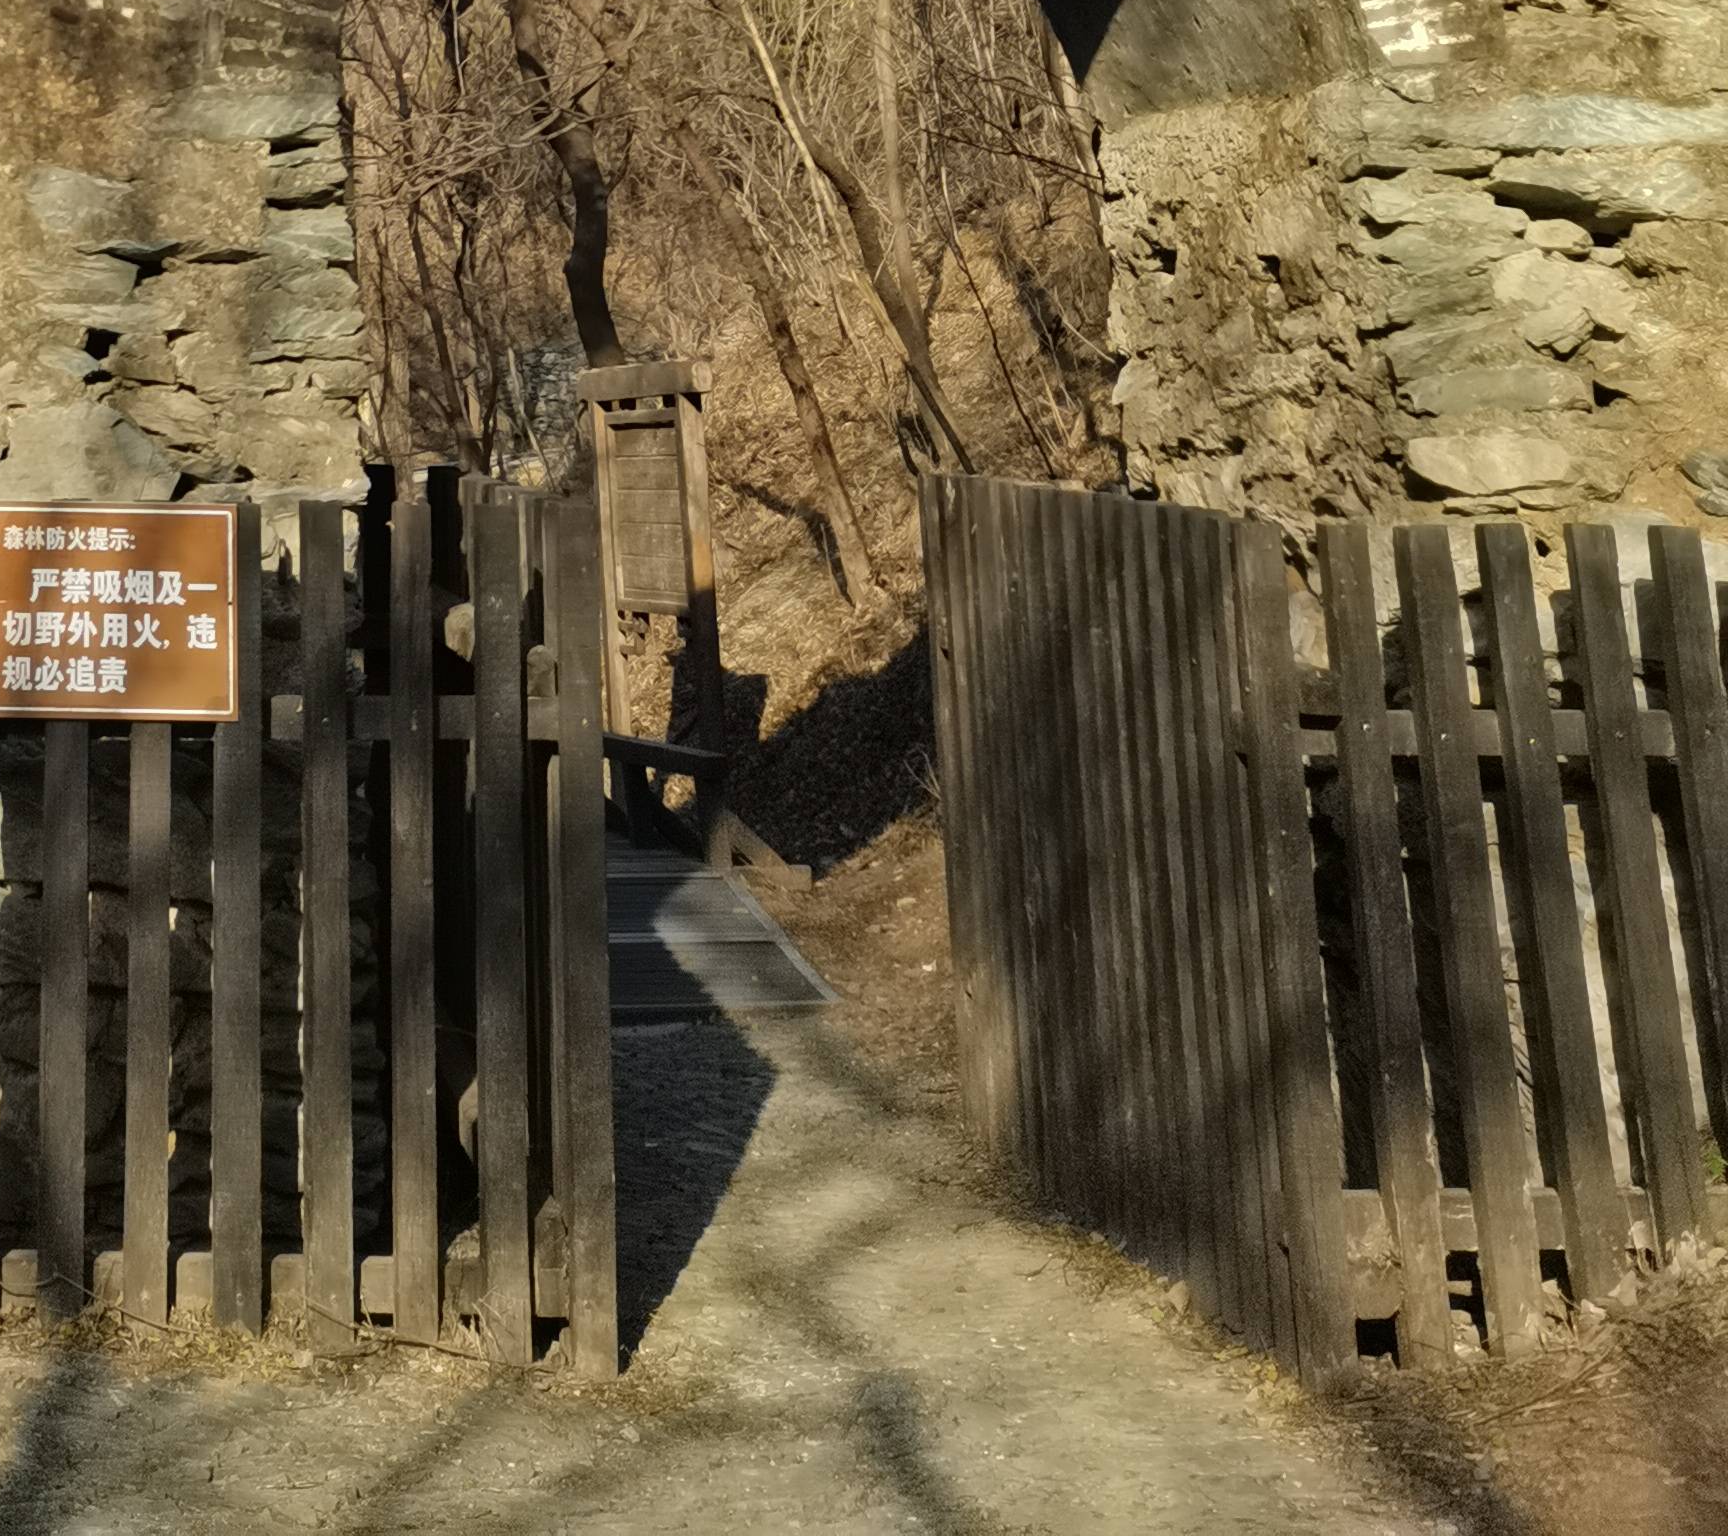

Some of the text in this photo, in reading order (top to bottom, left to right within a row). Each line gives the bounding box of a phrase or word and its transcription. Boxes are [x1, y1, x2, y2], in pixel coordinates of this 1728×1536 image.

[29, 568, 218, 605] 严禁吸烟及一
[1, 656, 128, 693] 规必追责
